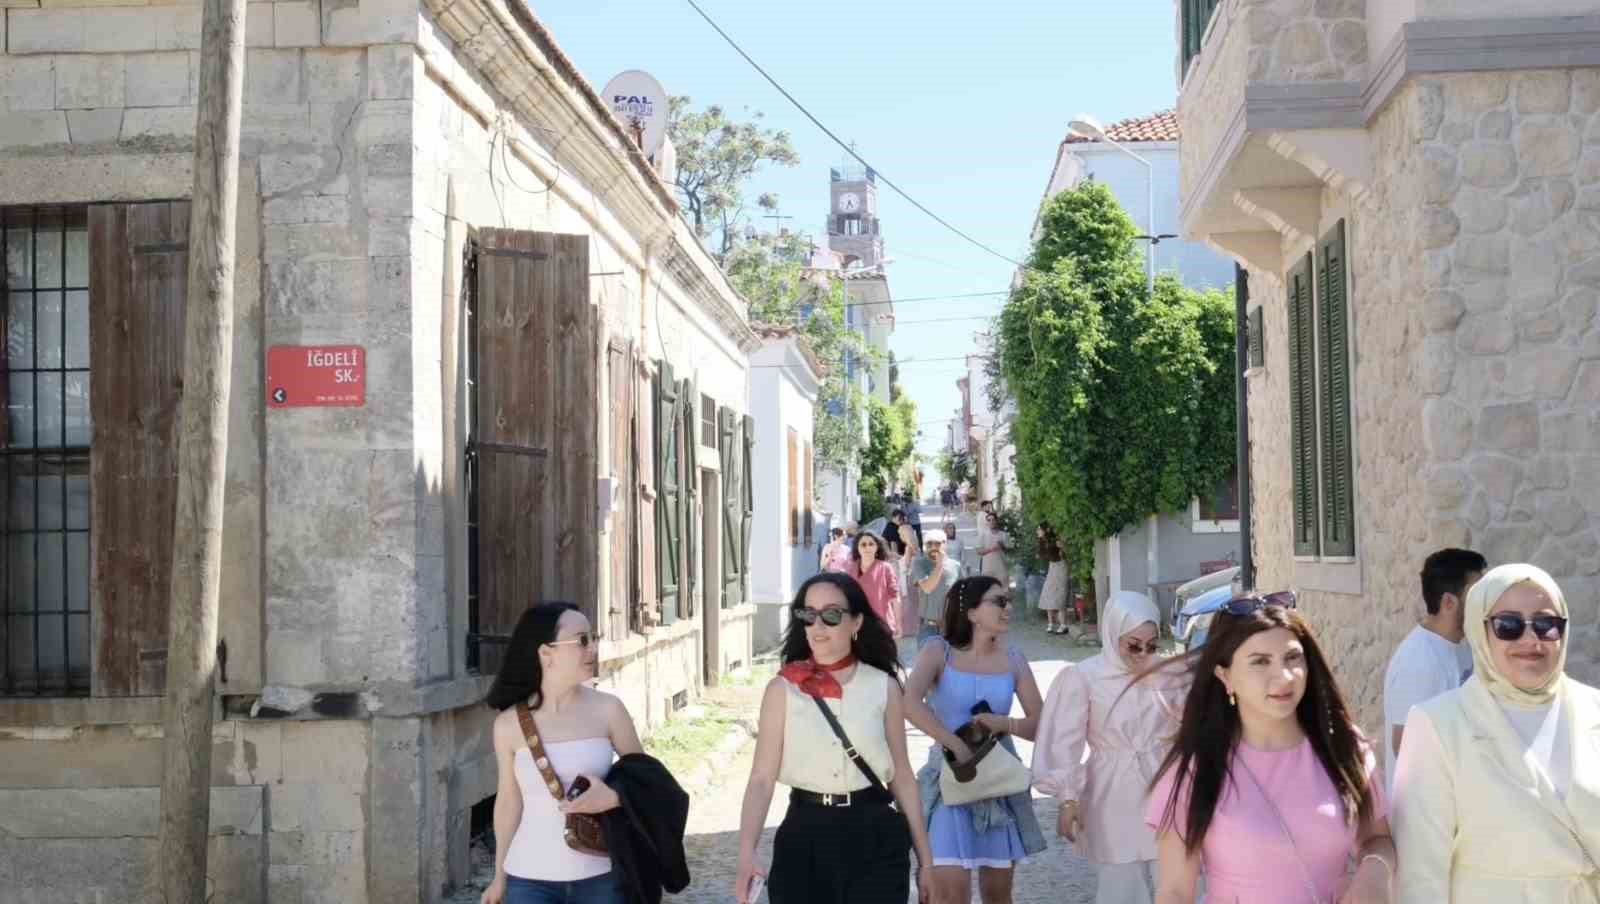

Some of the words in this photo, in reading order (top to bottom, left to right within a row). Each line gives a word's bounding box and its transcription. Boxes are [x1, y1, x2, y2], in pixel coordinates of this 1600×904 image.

[614, 95, 652, 104] PAL
[307, 349, 357, 367] İĞDELİ
[335, 368, 357, 383] SK.
